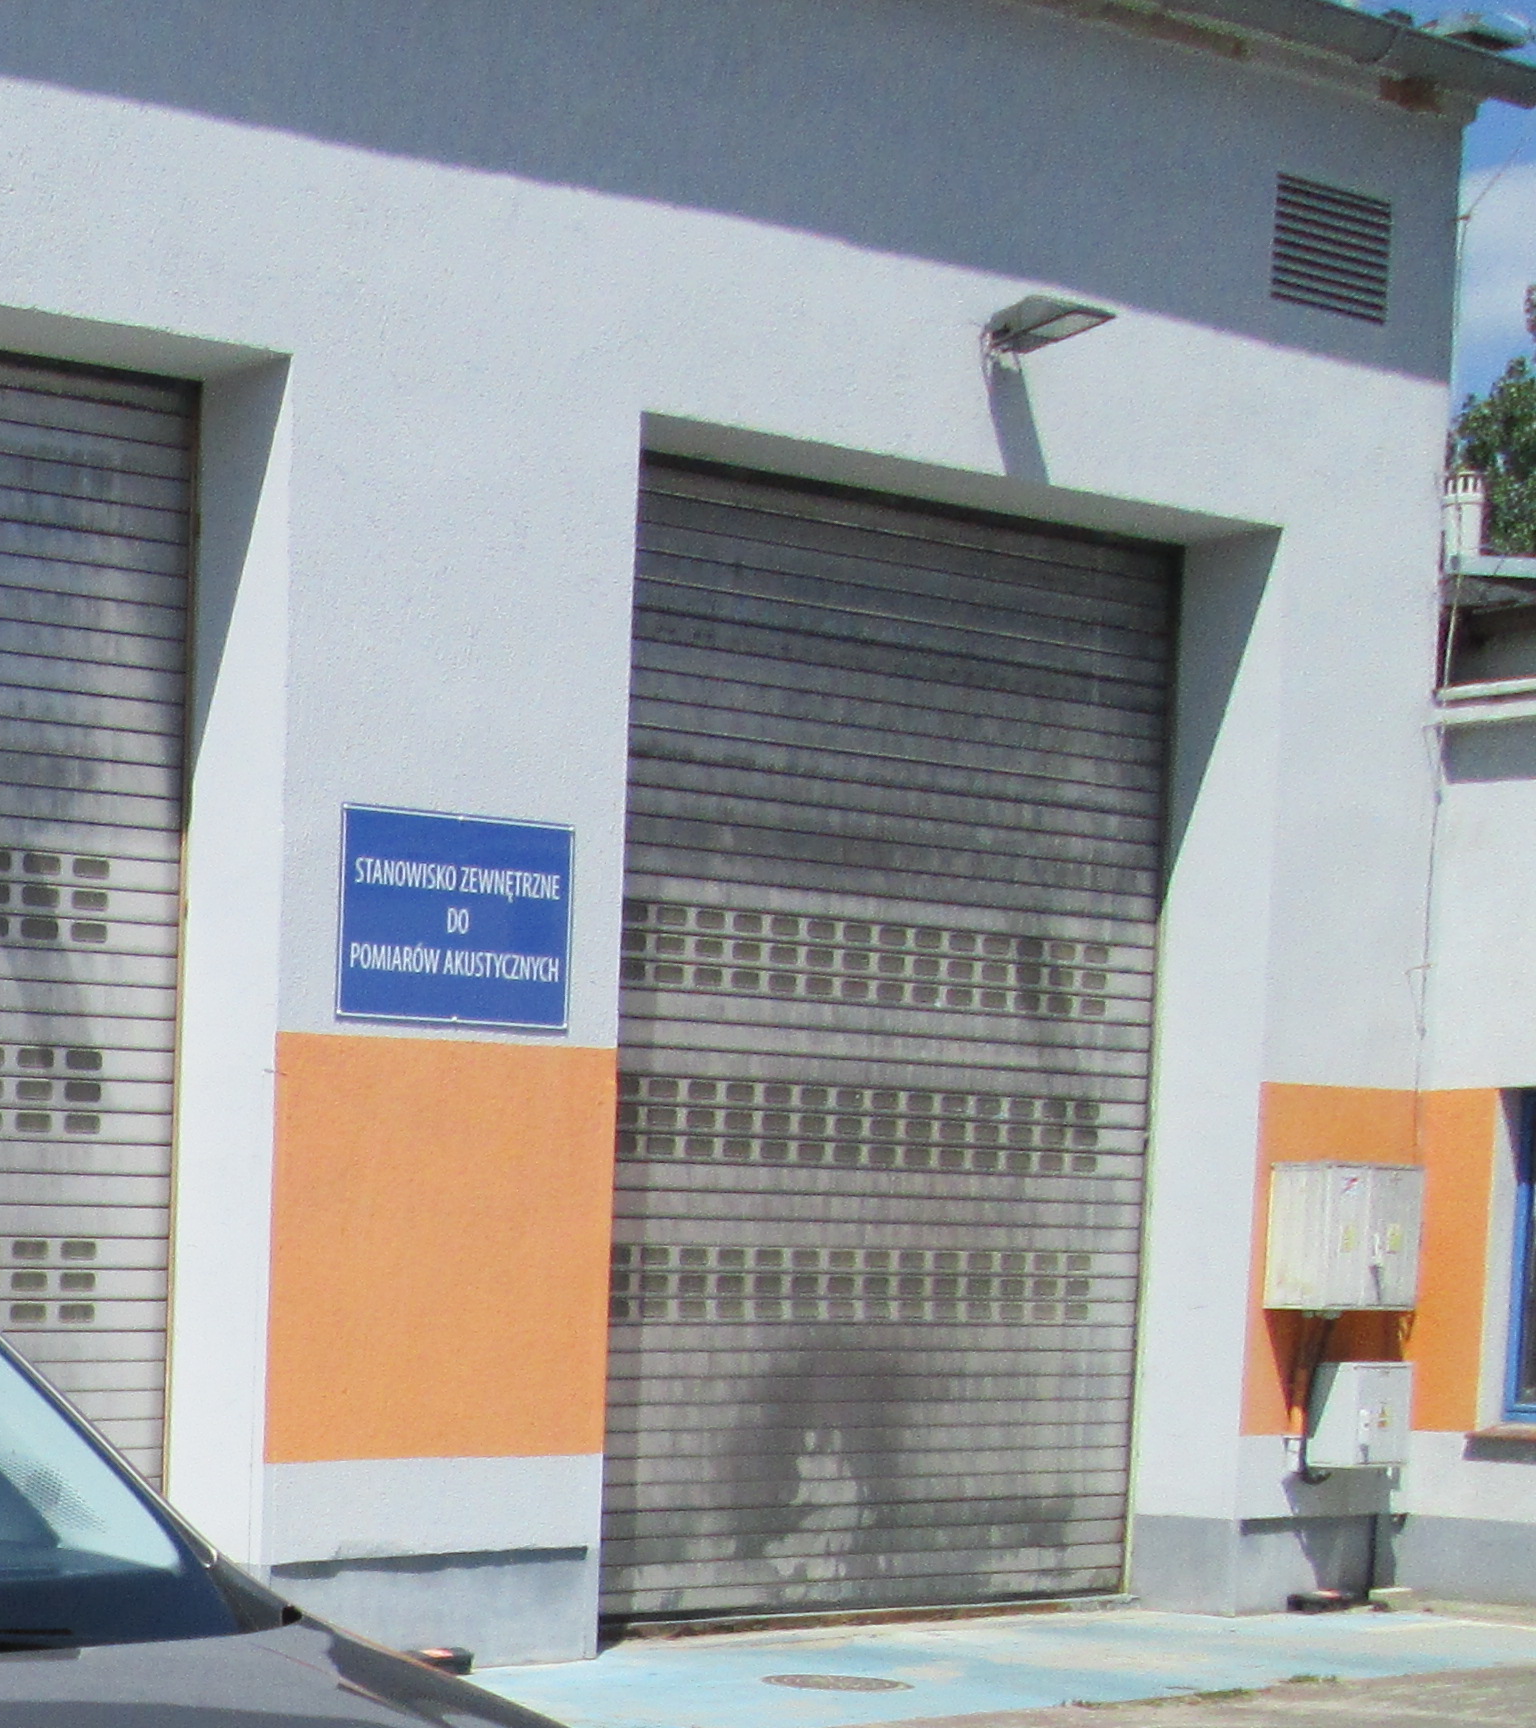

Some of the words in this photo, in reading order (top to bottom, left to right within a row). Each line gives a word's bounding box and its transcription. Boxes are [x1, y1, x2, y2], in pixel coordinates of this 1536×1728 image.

[354, 857, 457, 891] STANOWISKO
[459, 866, 561, 903] ZEWNĘTRZNE
[446, 907, 470, 934] DO
[350, 942, 440, 975] POMIARÓW
[442, 951, 560, 983] AKUSTYCZNYCH
